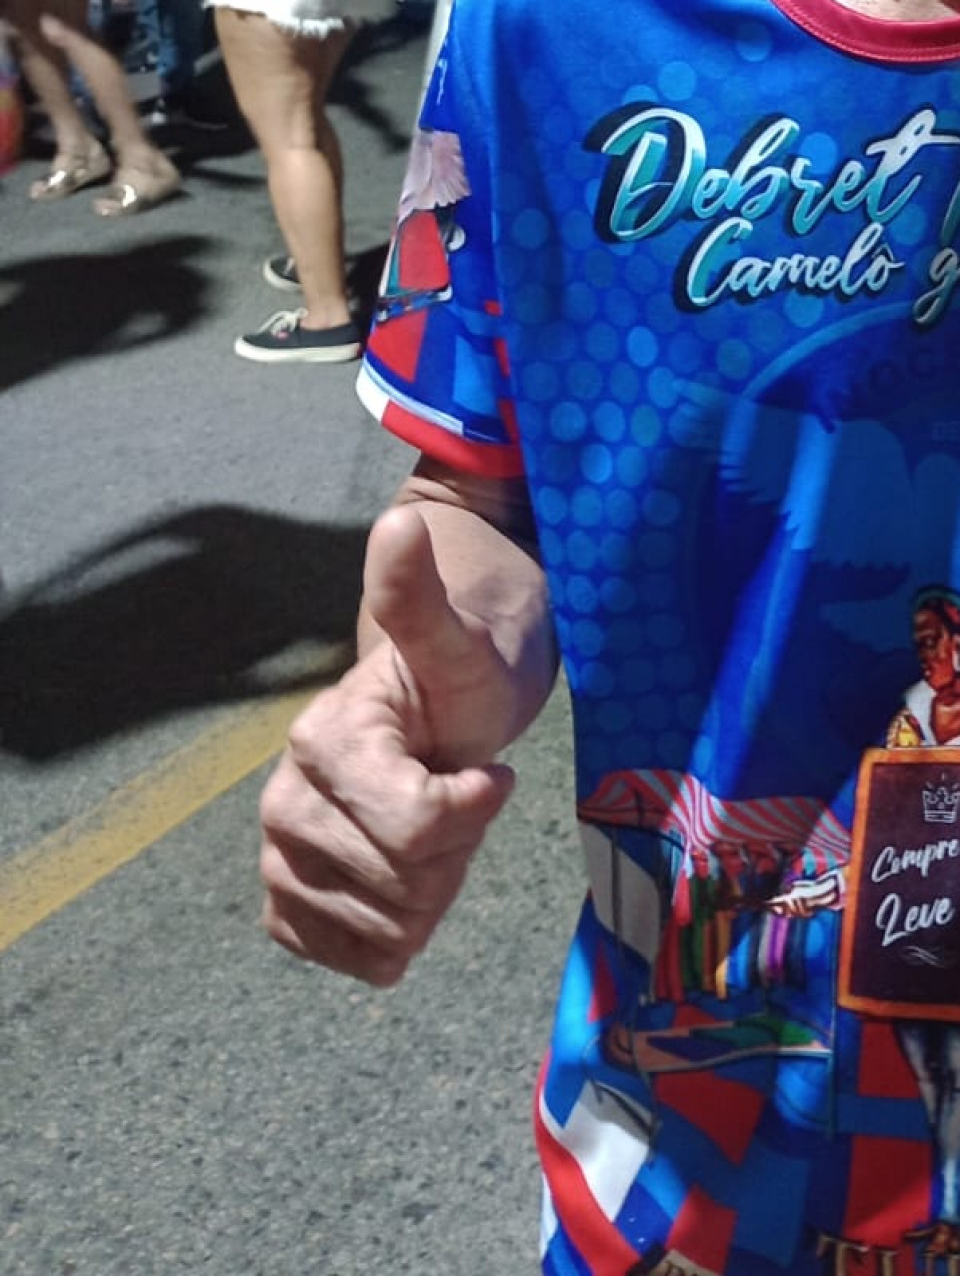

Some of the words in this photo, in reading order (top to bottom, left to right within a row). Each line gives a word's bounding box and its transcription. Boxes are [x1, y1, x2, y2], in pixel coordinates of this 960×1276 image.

[685, 216, 905, 307] Camelô
[870, 838, 960, 883] Compre
[876, 892, 956, 947] Leve
